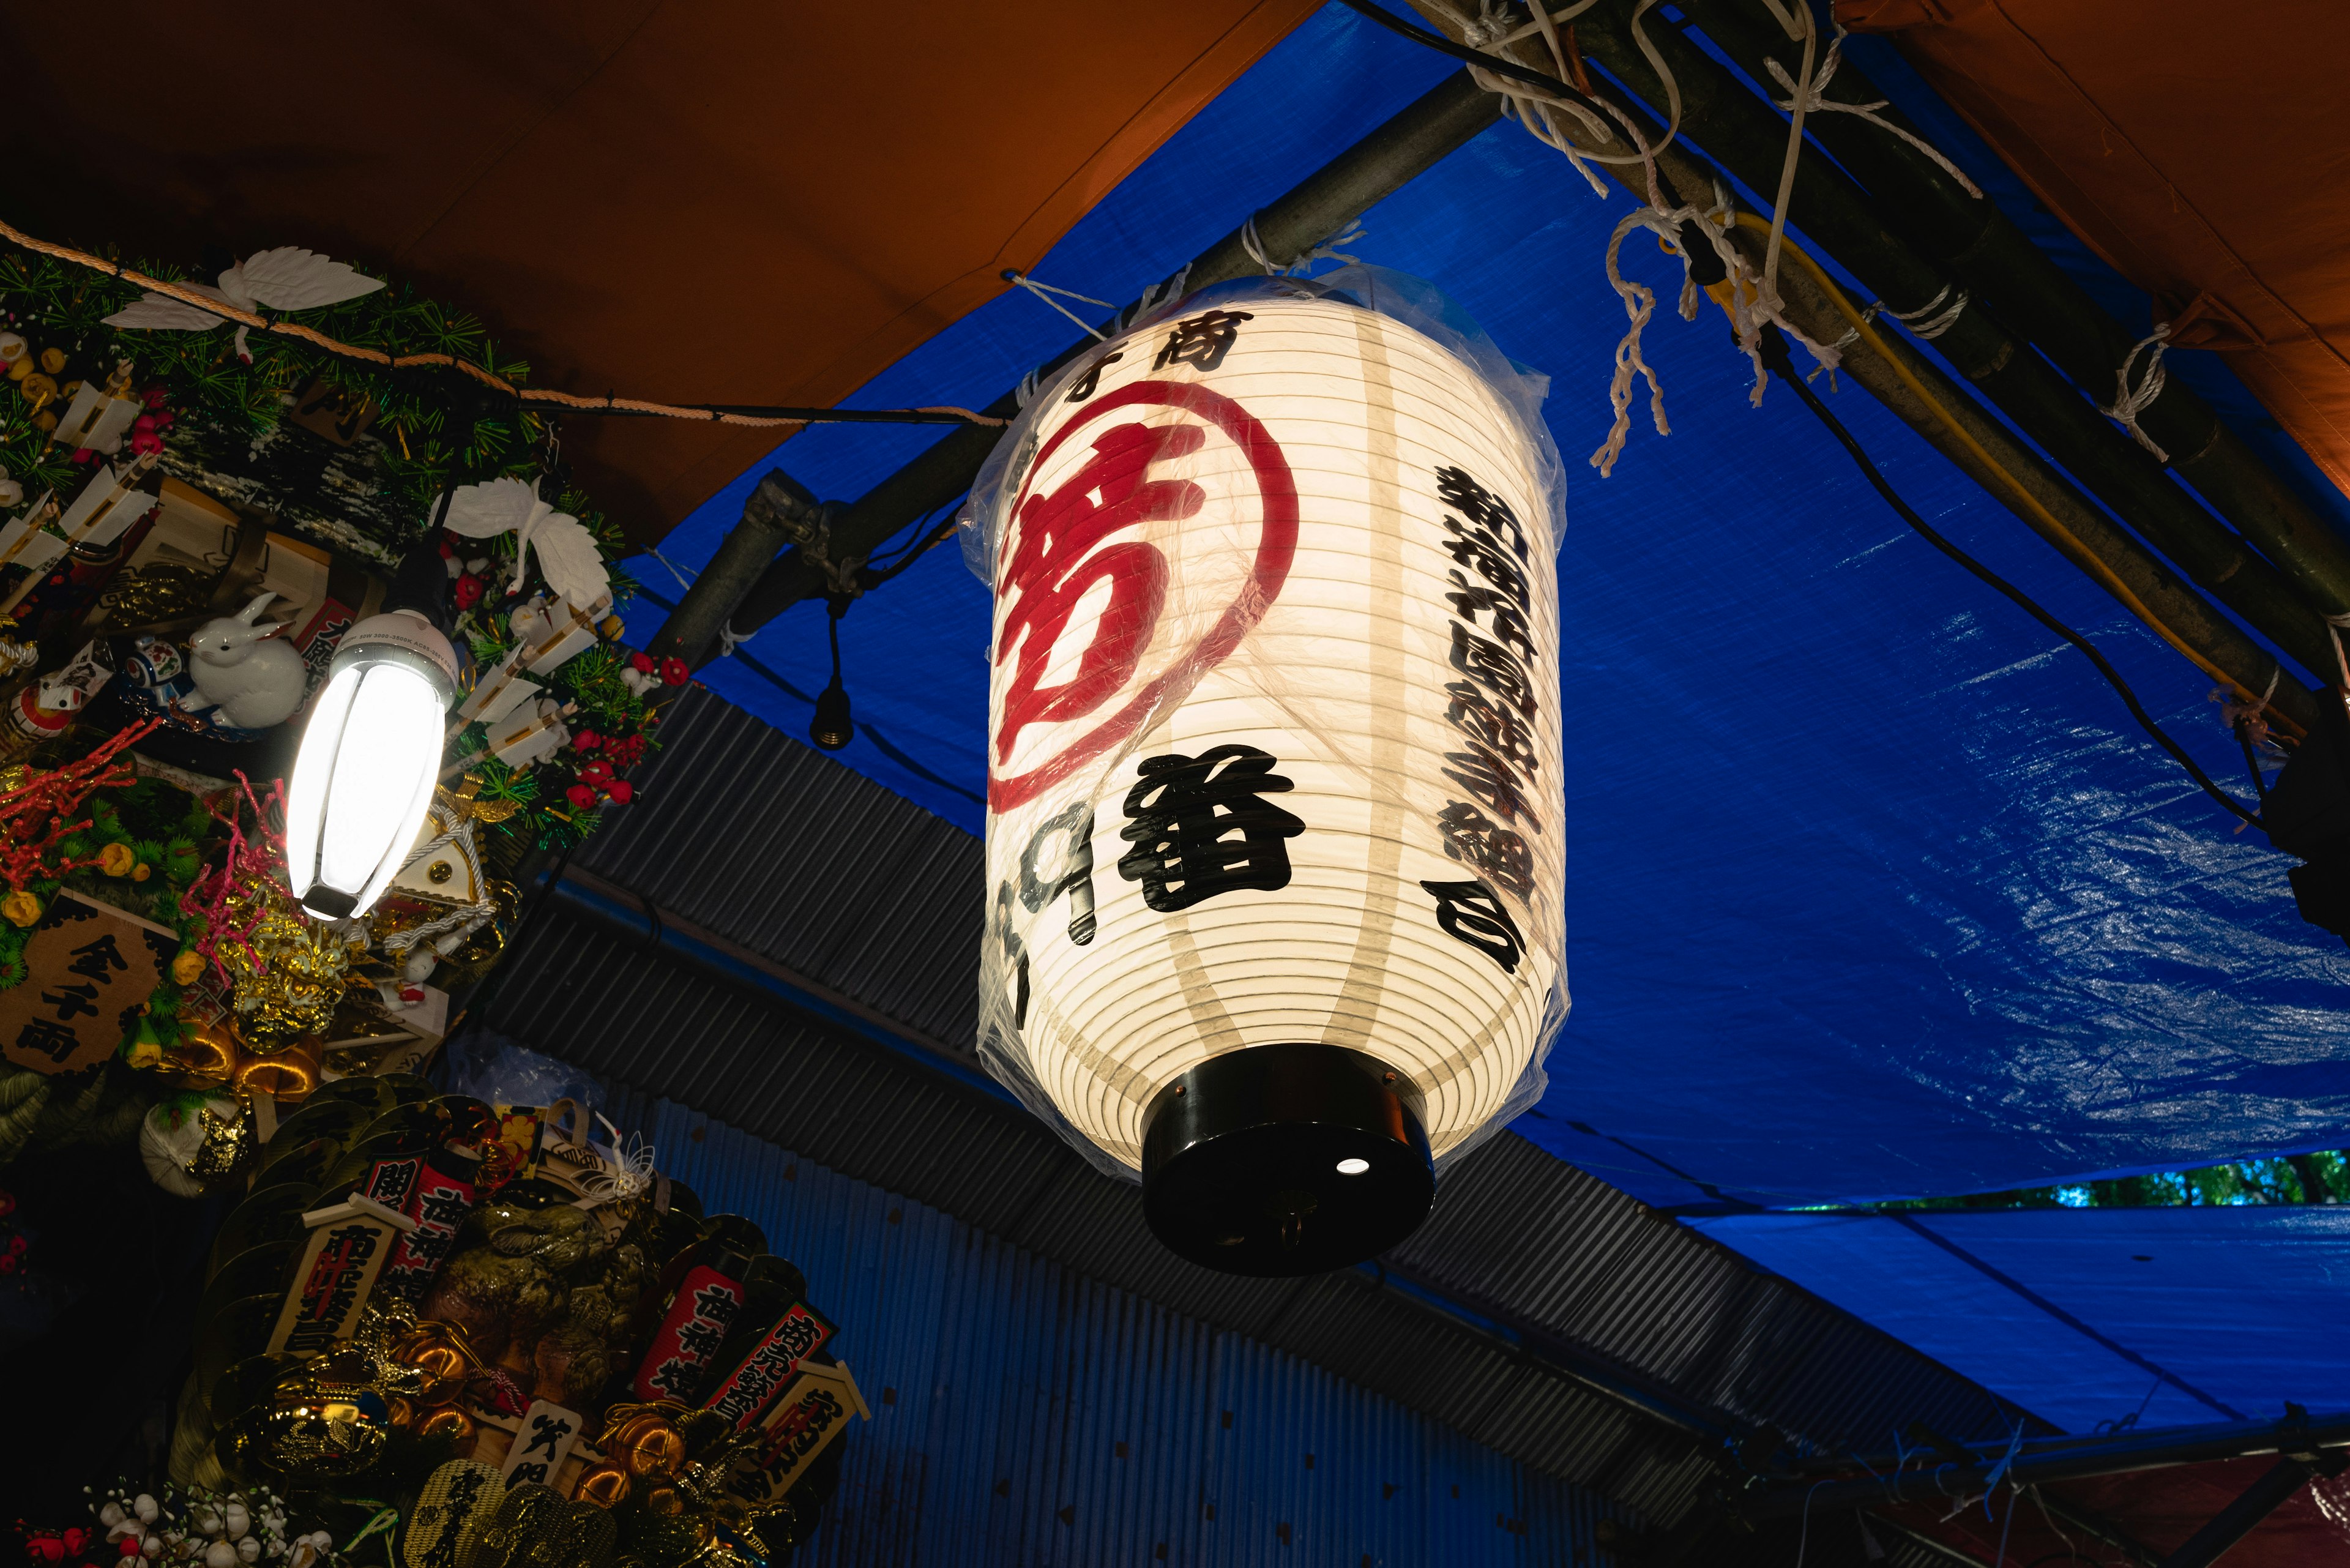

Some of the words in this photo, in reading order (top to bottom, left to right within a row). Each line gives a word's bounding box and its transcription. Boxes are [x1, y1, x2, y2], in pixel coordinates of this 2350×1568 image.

[373, 633, 413, 644] 3000-3500K
[16, 934, 129, 1064] 金千両
[726, 1388, 844, 1503] 家内安全
